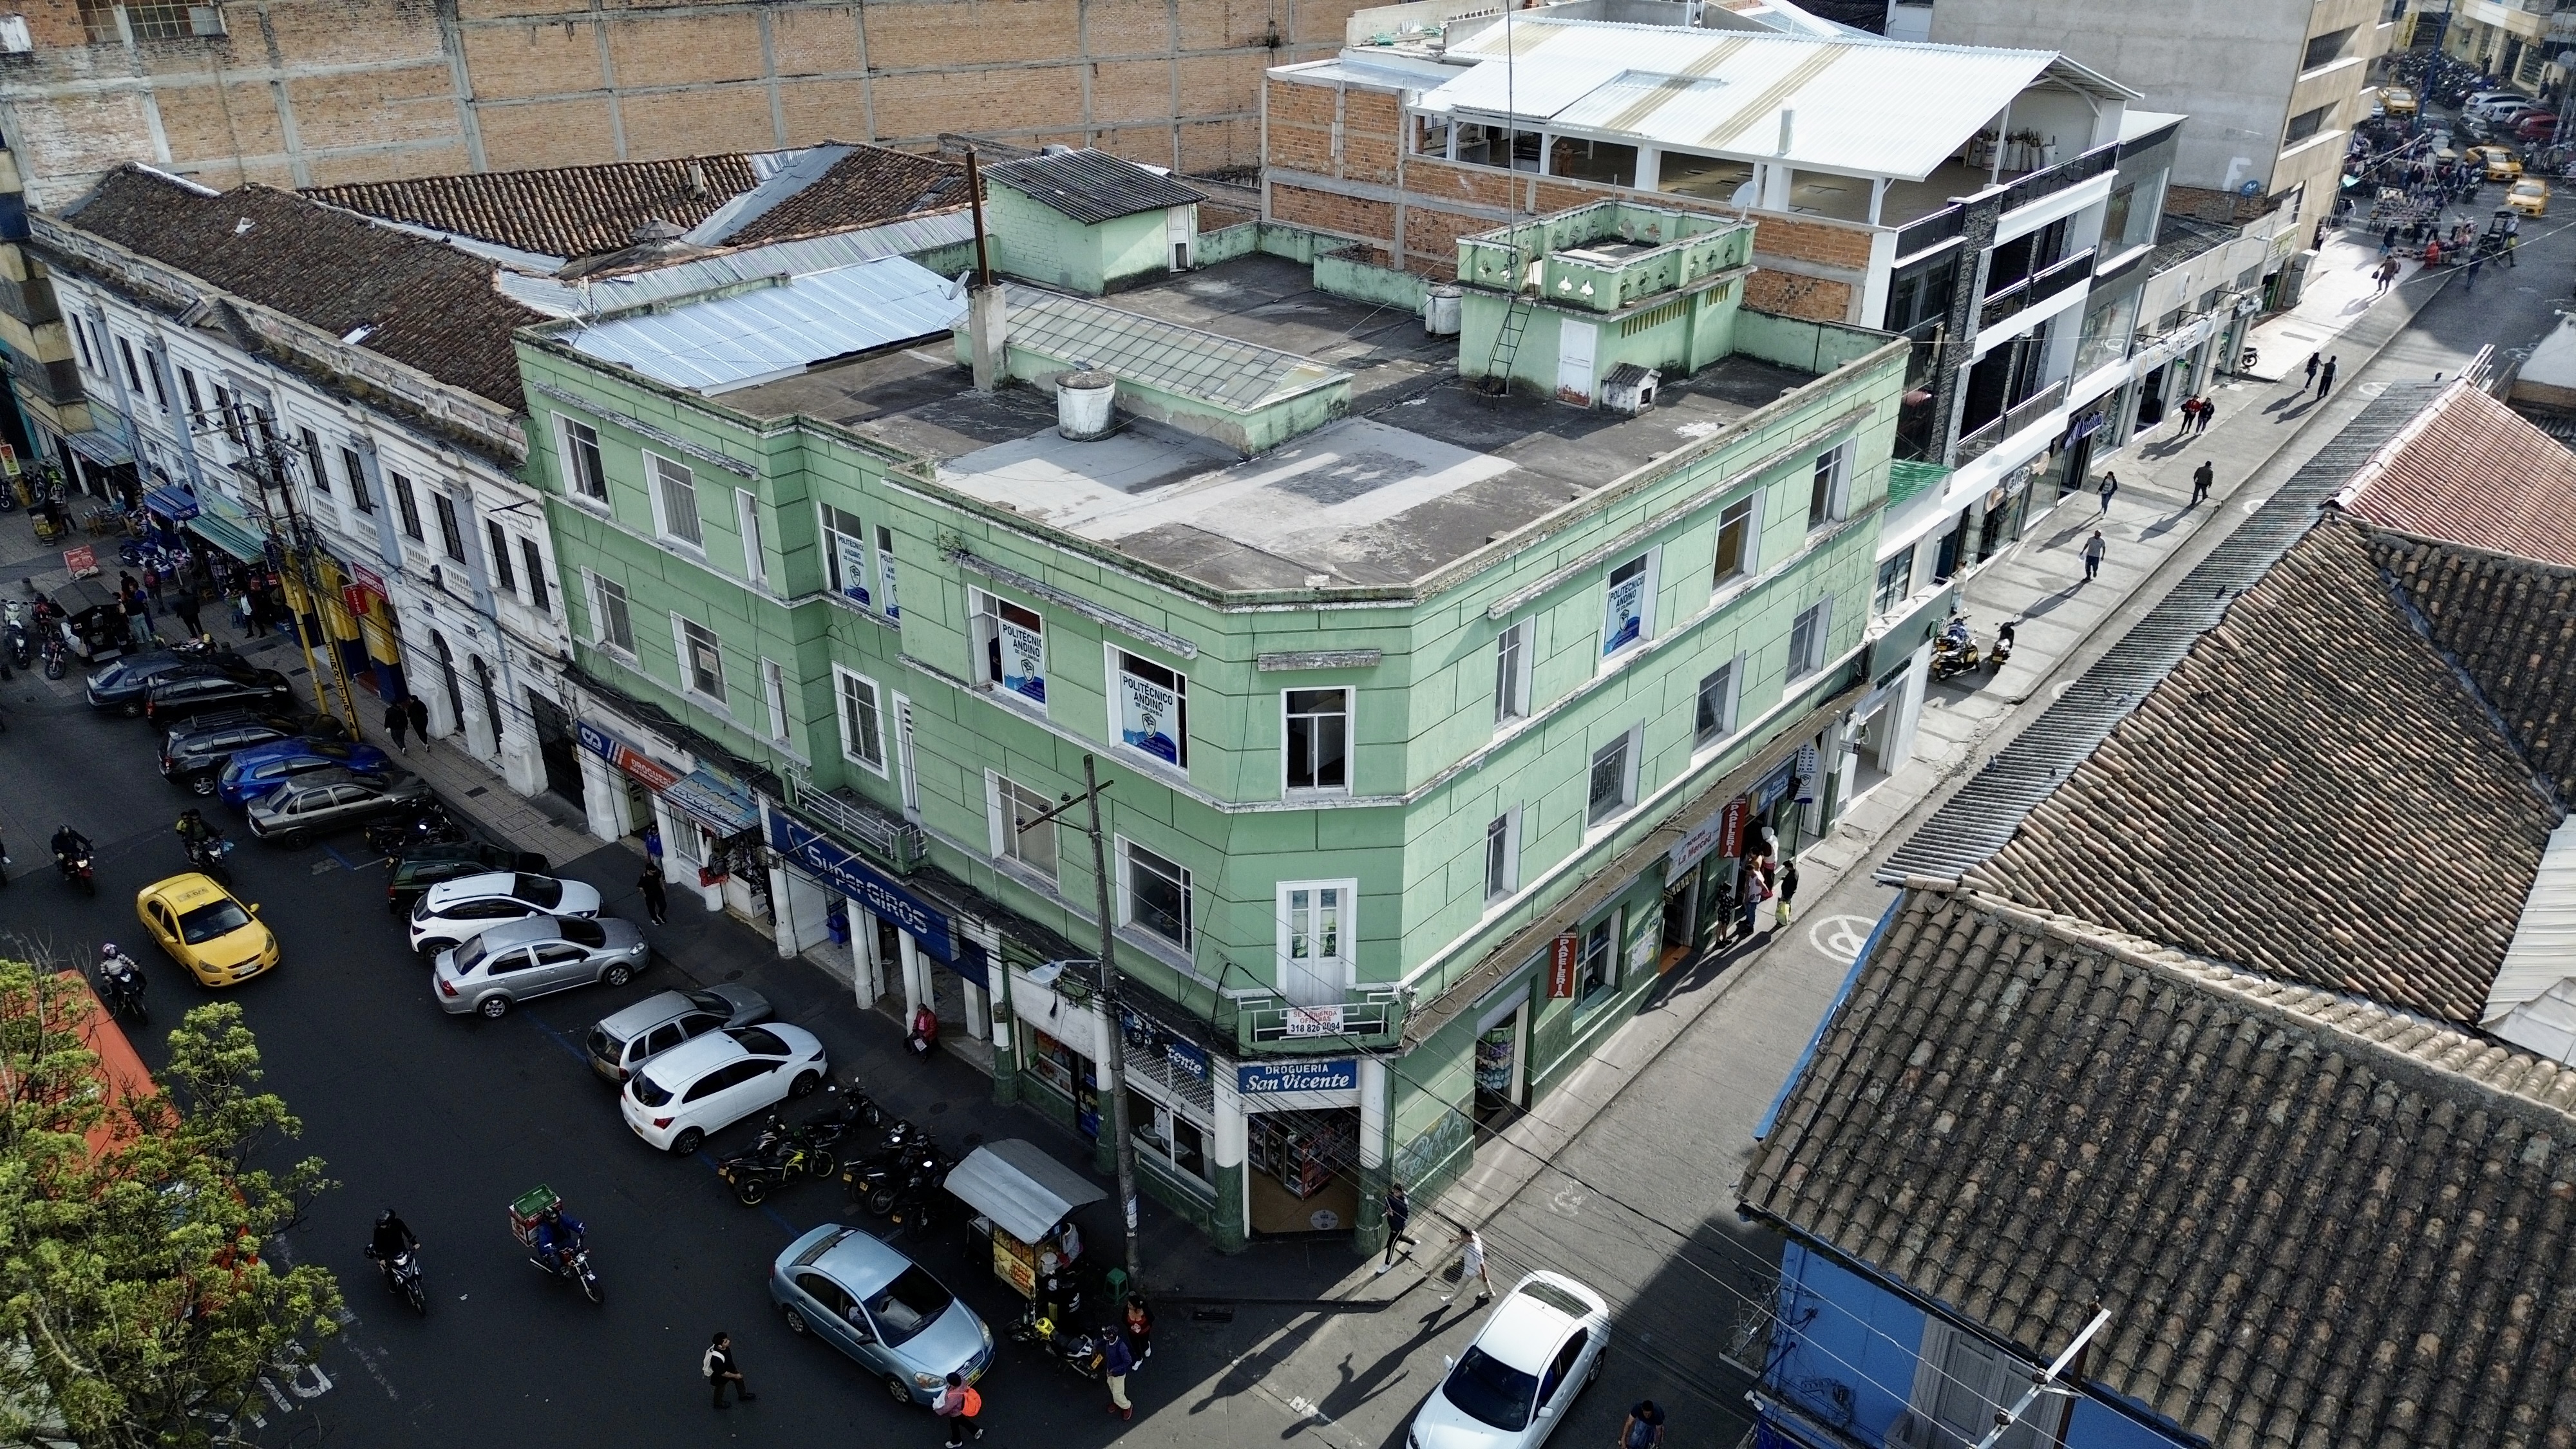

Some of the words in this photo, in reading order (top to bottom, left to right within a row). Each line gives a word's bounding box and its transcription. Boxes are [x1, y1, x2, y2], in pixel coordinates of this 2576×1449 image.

[1610, 576, 1643, 602] POLITÉCNICO
[1616, 589, 1636, 608] ANDINO
[1013, 639, 1040, 657] ANDINO
[326, 643, 355, 729] FERRETERIA
[1123, 676, 1173, 705] POLITÉCNICO
[1133, 692, 1164, 712] ANDINO
[1723, 804, 1739, 858] PAPELERIA
[1678, 855, 1687, 866] La
[1554, 939, 1569, 997] PAPELERIA
[1291, 1024, 1305, 1032] 318
[1307, 1023, 1320, 1032] 826
[1265, 1064, 1329, 1074] DROGUERIA
[1245, 1075, 1279, 1091] San
[1282, 1073, 1350, 1089] Vicente
